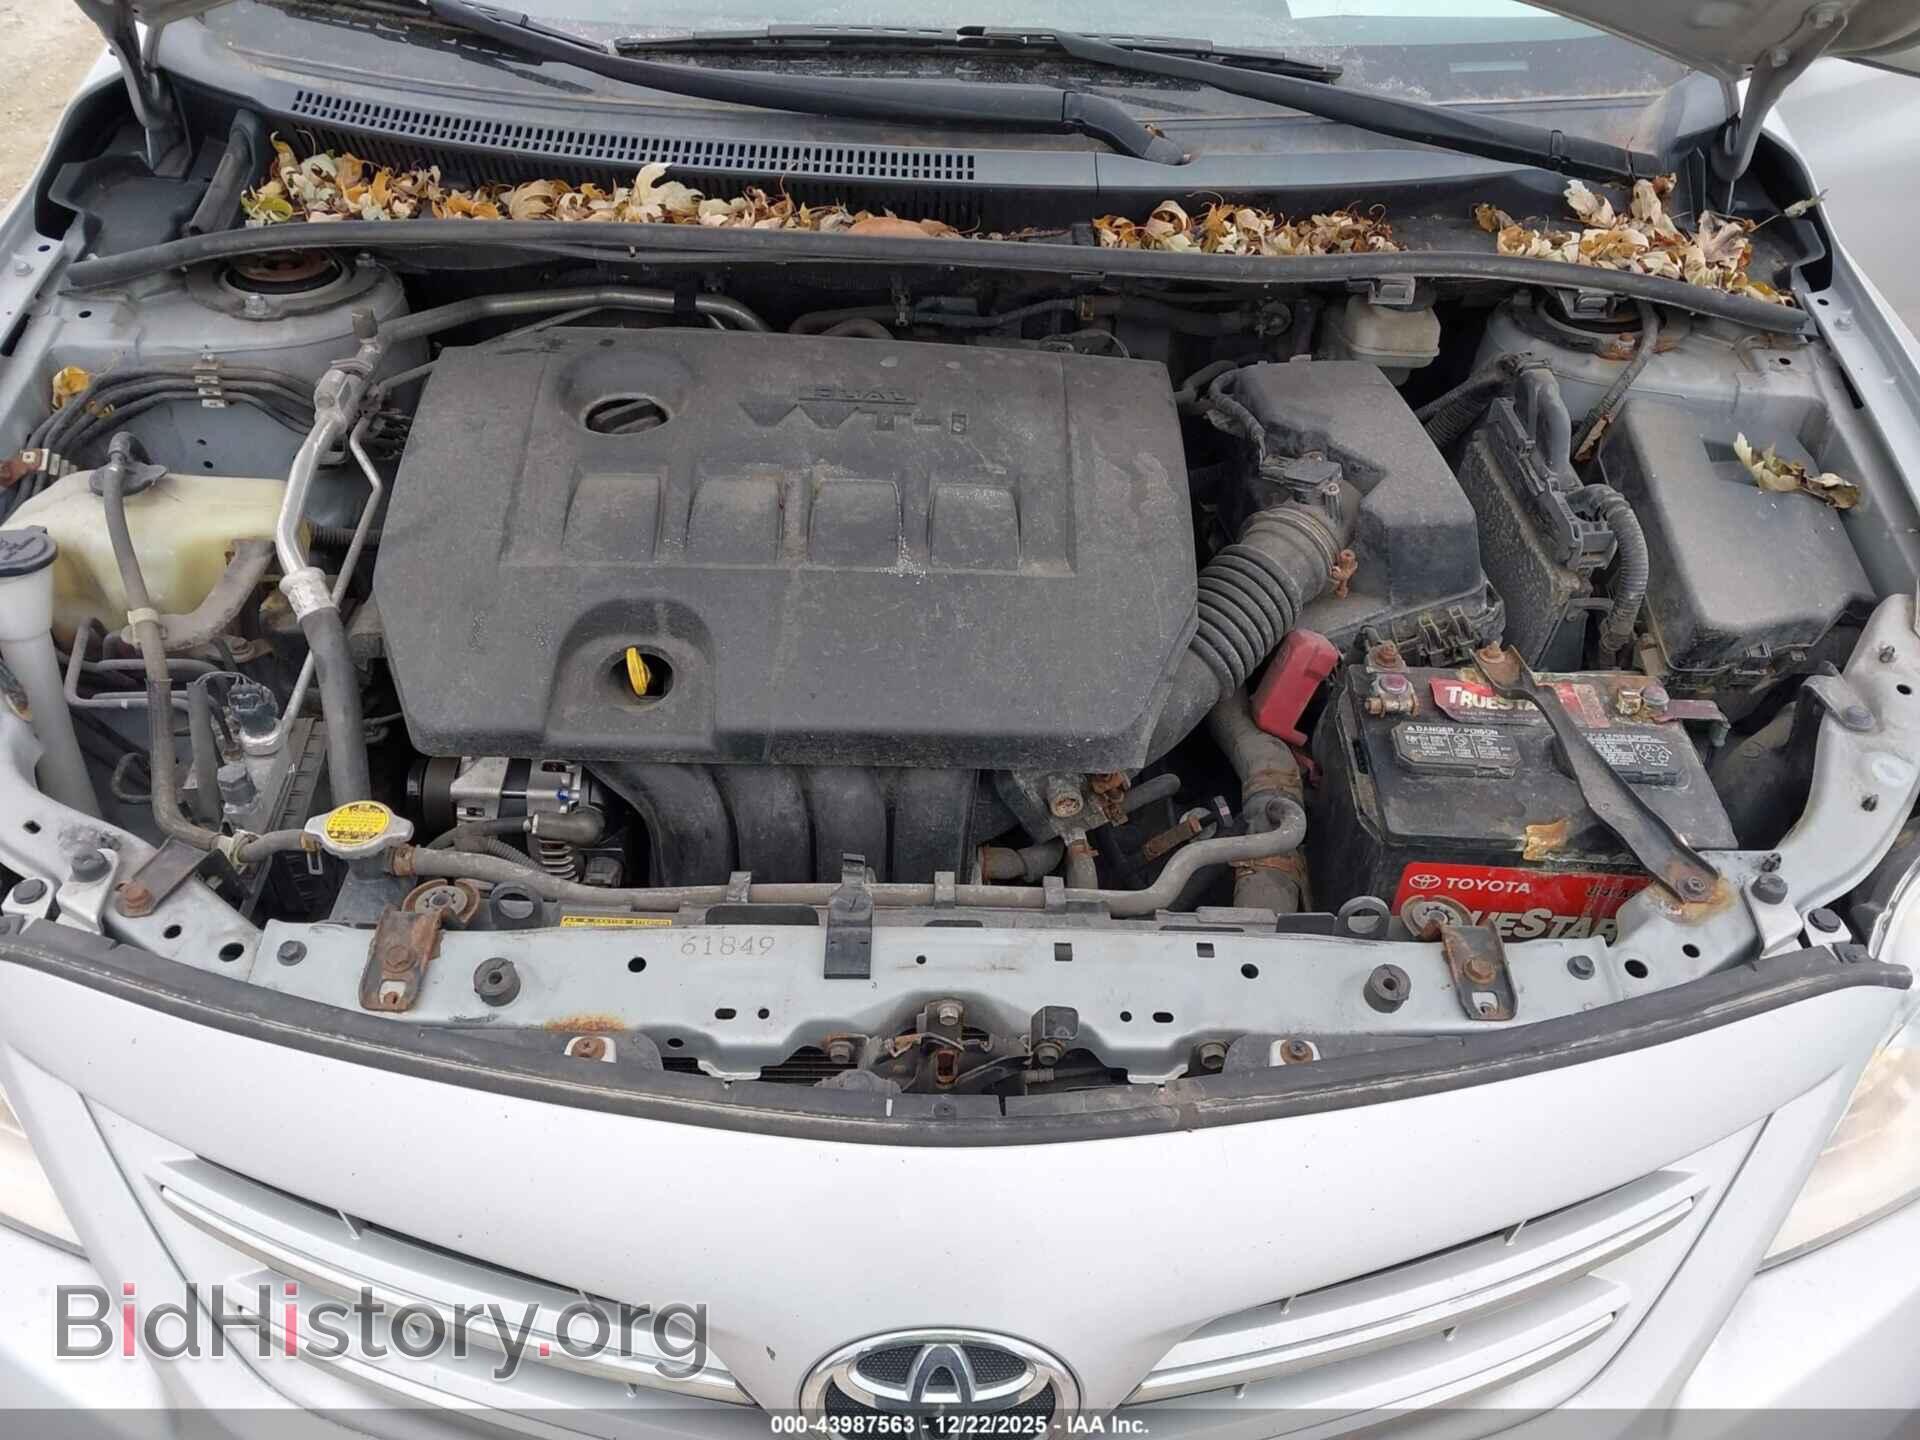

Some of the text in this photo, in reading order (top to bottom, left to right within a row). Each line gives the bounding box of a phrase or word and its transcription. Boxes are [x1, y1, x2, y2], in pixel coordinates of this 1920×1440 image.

[1444, 686, 1540, 712] TRUESTA
[1446, 877, 1531, 894] TOYOTA
[681, 935, 776, 956] 61849
